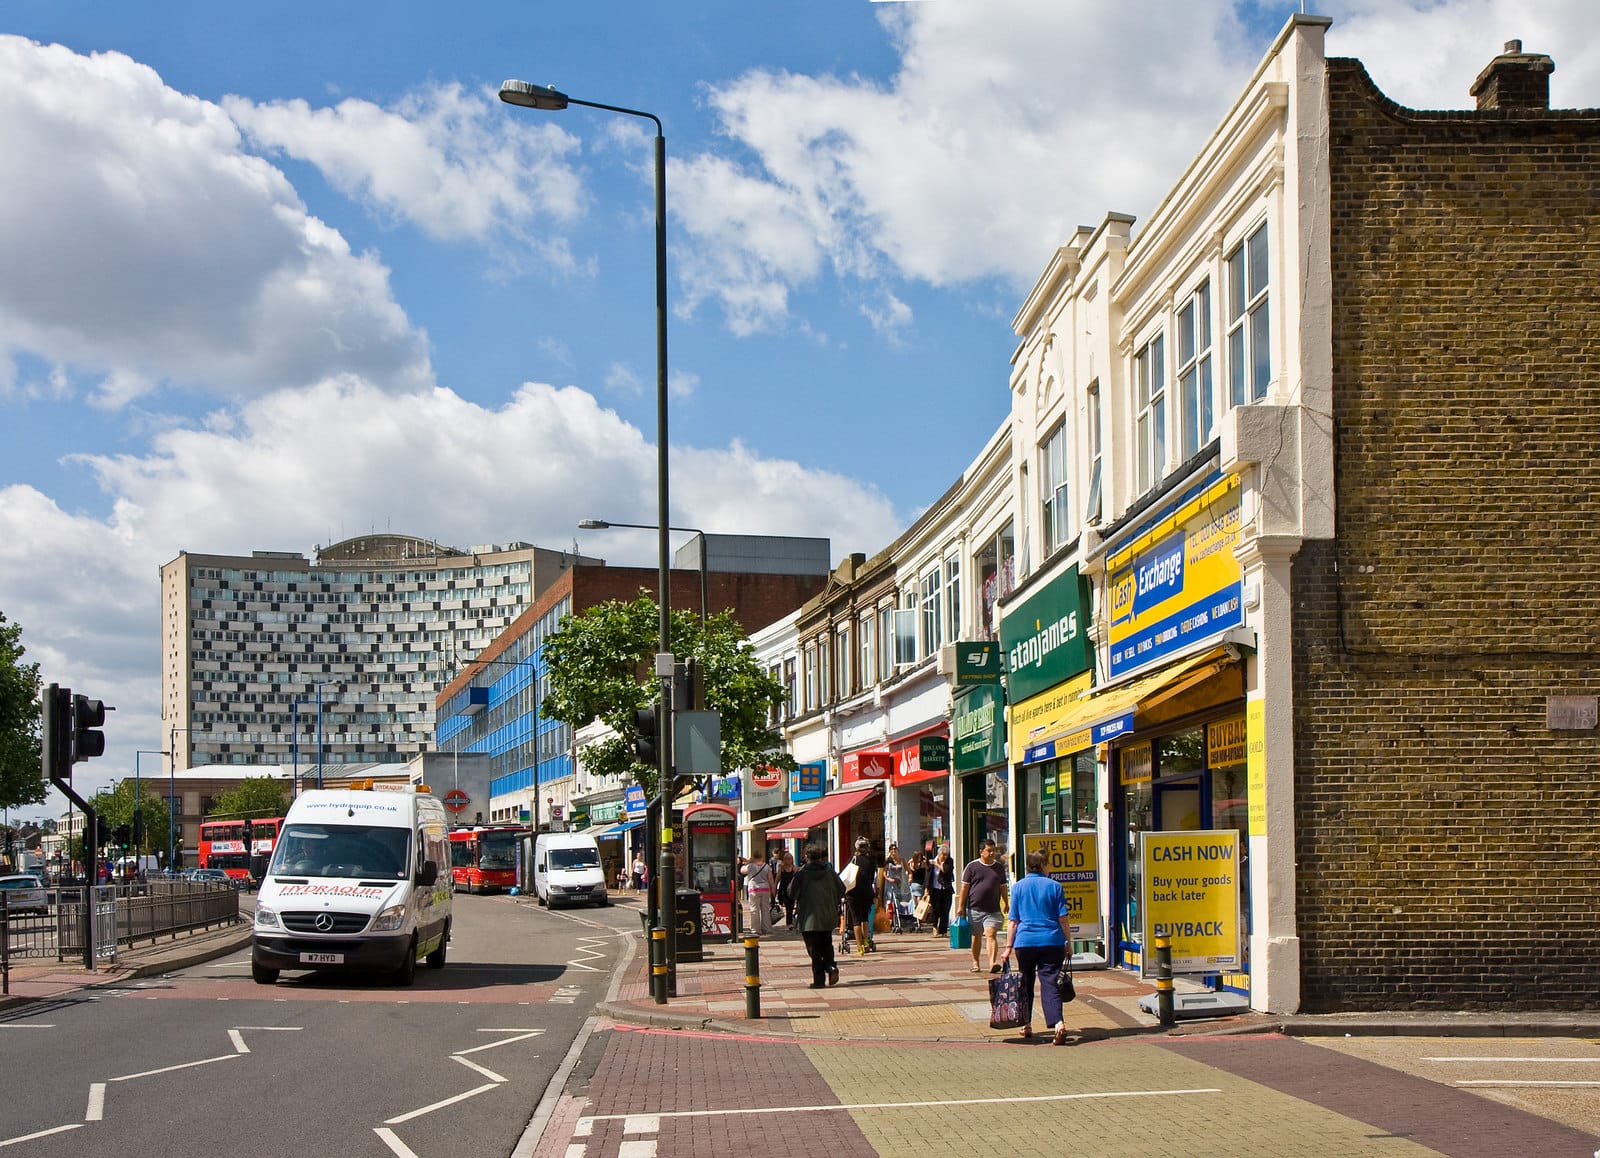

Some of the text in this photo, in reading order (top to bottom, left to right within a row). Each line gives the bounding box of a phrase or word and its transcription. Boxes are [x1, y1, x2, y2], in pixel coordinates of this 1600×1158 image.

[1113, 551, 1182, 610] Cash Exchange
[1010, 610, 1077, 673] stanjames
[966, 646, 989, 667] sj
[1210, 719, 1247, 749] BUYBAC
[306, 802, 398, 812] www.hydraquip.co.uk
[1062, 840, 1084, 850] BUY
[1152, 844, 1233, 862] CASH NOW
[1052, 852, 1084, 868] OLD
[1051, 871, 1094, 881] PRICES PAID
[1152, 874, 1232, 890] Buy your goods
[279, 885, 383, 896] HYDRAQUIP
[1153, 890, 1206, 901] back later
[1065, 897, 1083, 911] SH
[1153, 921, 1223, 937] BUYBACK
